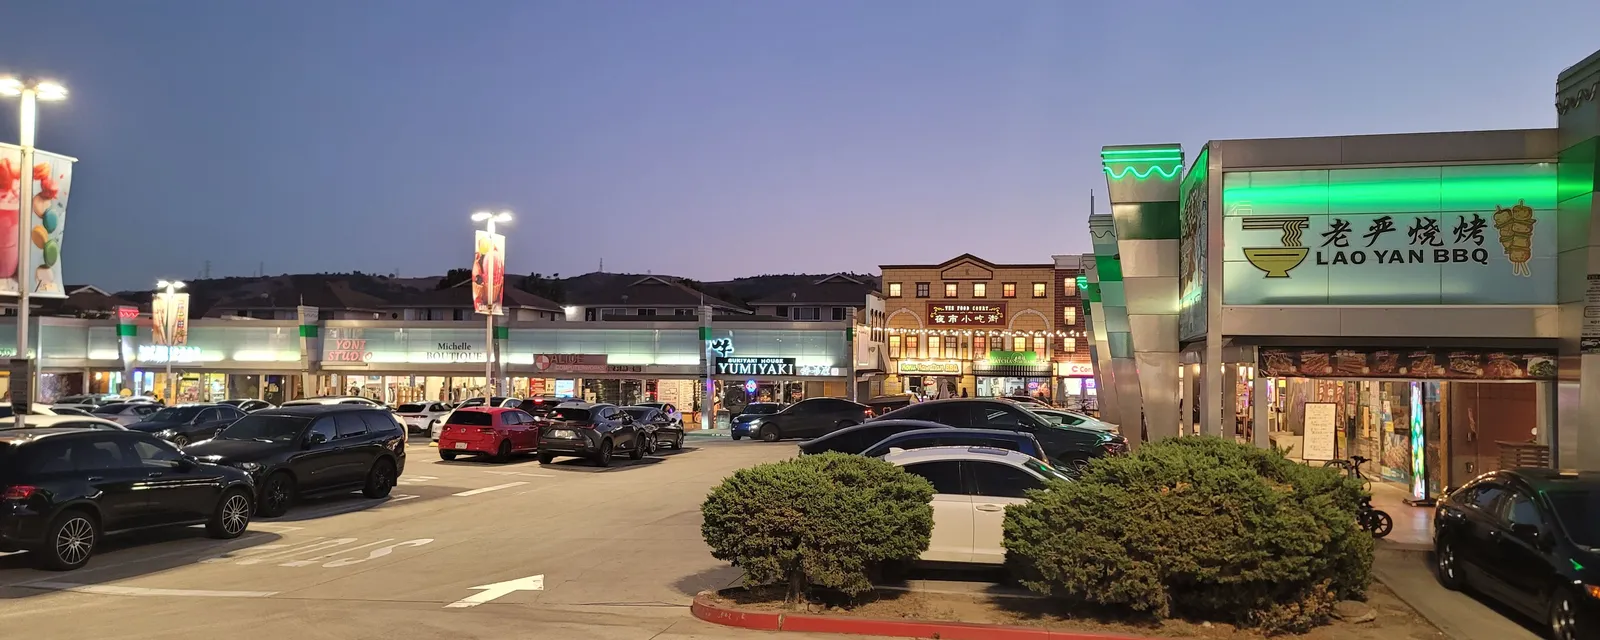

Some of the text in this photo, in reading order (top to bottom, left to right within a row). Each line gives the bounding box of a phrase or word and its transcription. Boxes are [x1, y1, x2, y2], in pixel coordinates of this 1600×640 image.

[1320, 213, 1488, 248] 老严烧烤
[1316, 248, 1489, 266] LAO YAN BBQ
[437, 342, 472, 350] Michelle
[328, 351, 373, 361] STUDIO
[426, 351, 483, 361] BOUTIQUE
[718, 363, 793, 375] YUMIYAKI
